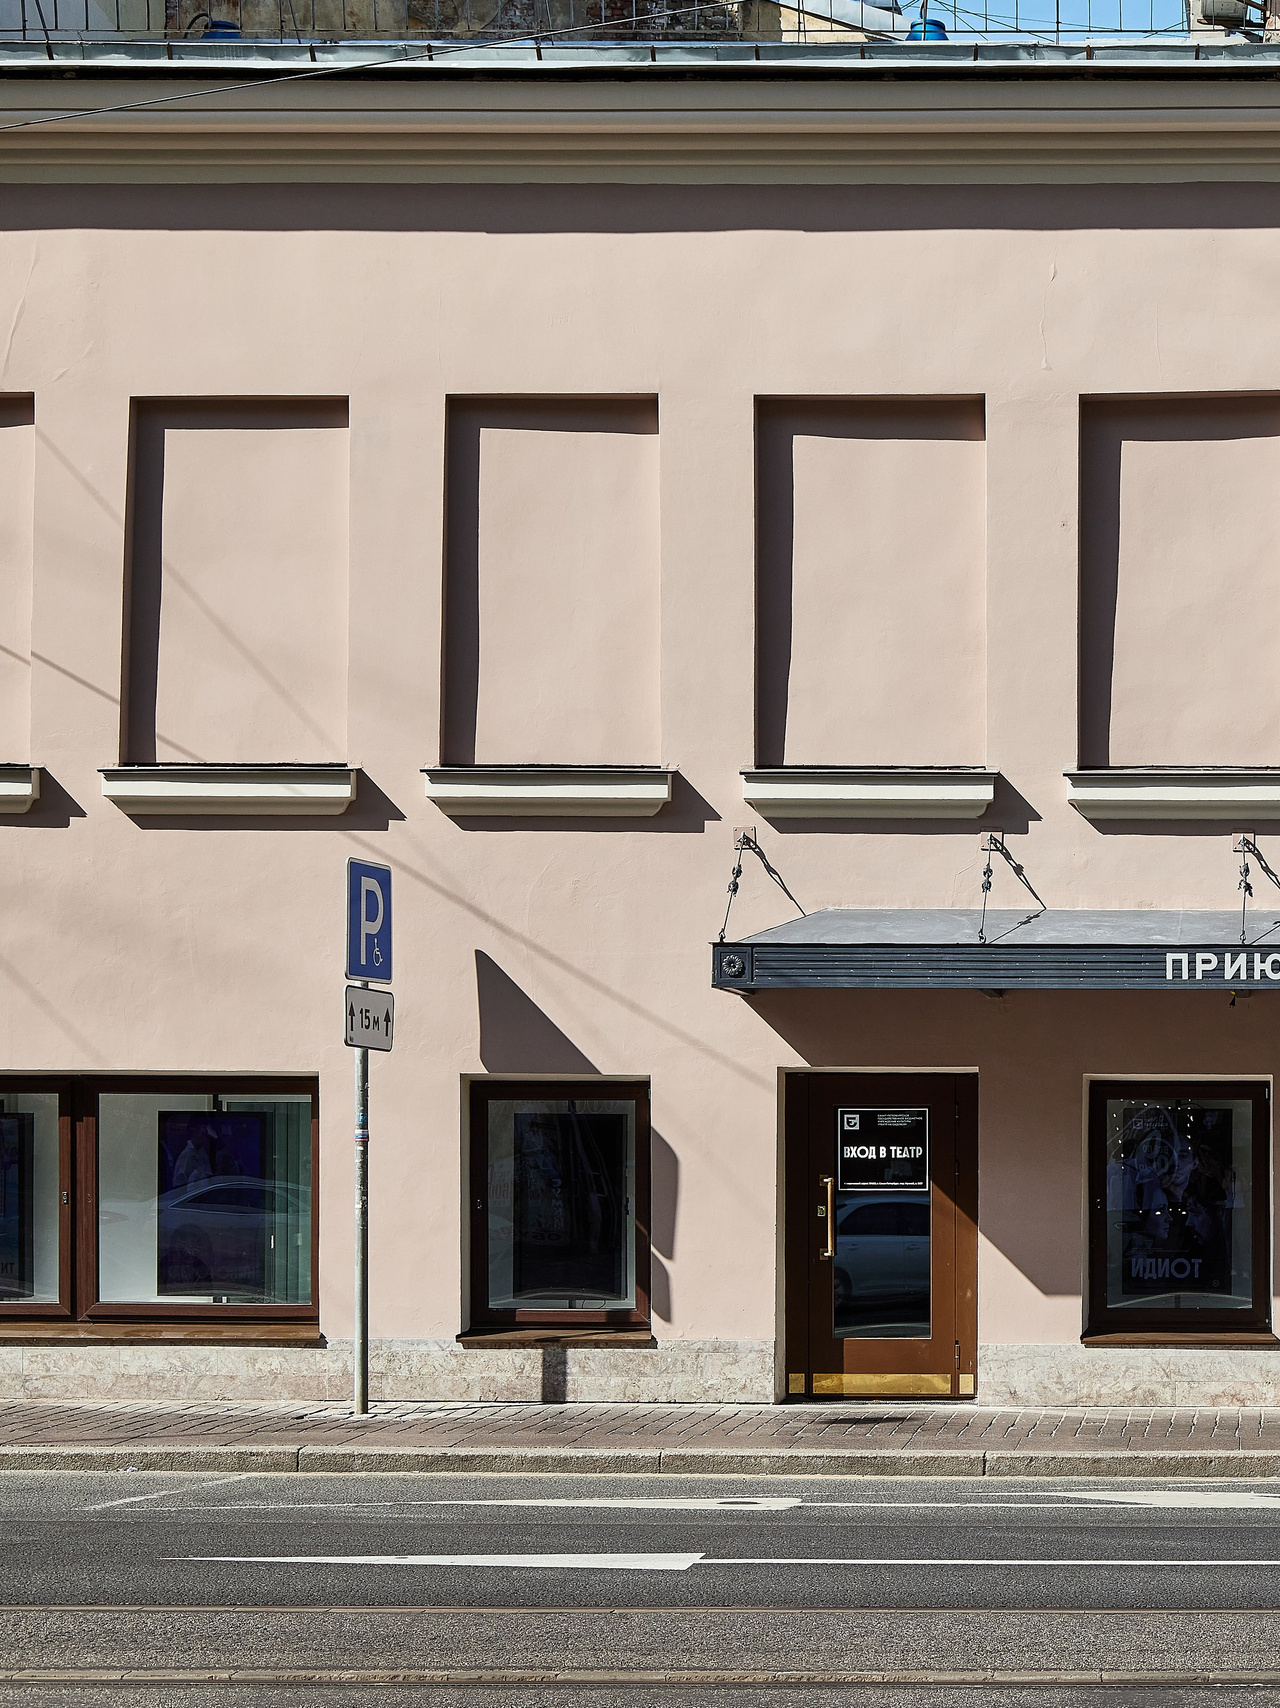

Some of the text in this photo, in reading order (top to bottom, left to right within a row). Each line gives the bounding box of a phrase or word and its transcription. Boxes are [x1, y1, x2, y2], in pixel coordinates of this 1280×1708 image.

[361, 876, 384, 965] P
[359, 1007, 371, 1030] 15
[843, 1146, 923, 1160] ВХОД В ТЕАТР
[1131, 1257, 1203, 1280] ИДИОТ
